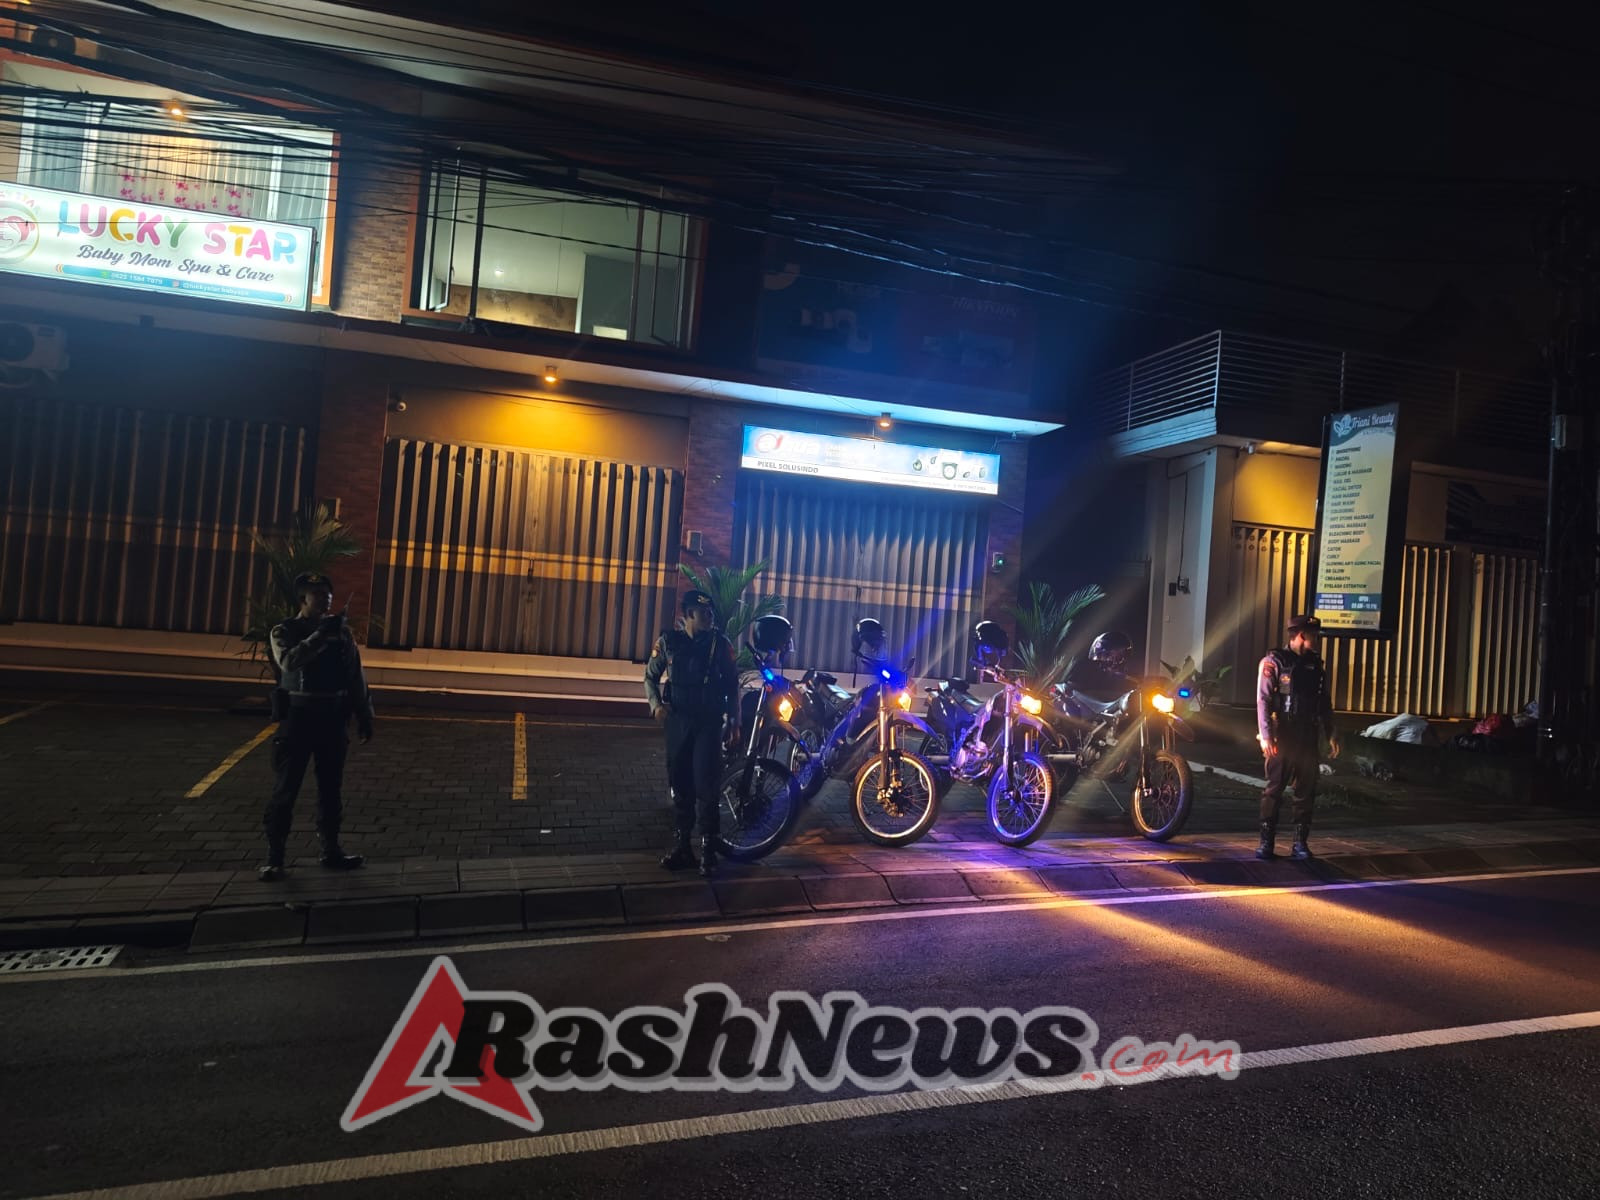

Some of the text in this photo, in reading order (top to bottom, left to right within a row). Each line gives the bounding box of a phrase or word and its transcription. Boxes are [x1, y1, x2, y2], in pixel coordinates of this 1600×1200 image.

[58, 200, 190, 249] LUCKY
[203, 222, 297, 264] STAR
[77, 244, 125, 266] Baby
[128, 251, 173, 269] Mom
[178, 258, 213, 275] Spa
[235, 266, 275, 282] Care
[778, 463, 819, 474] SOLUSINDO
